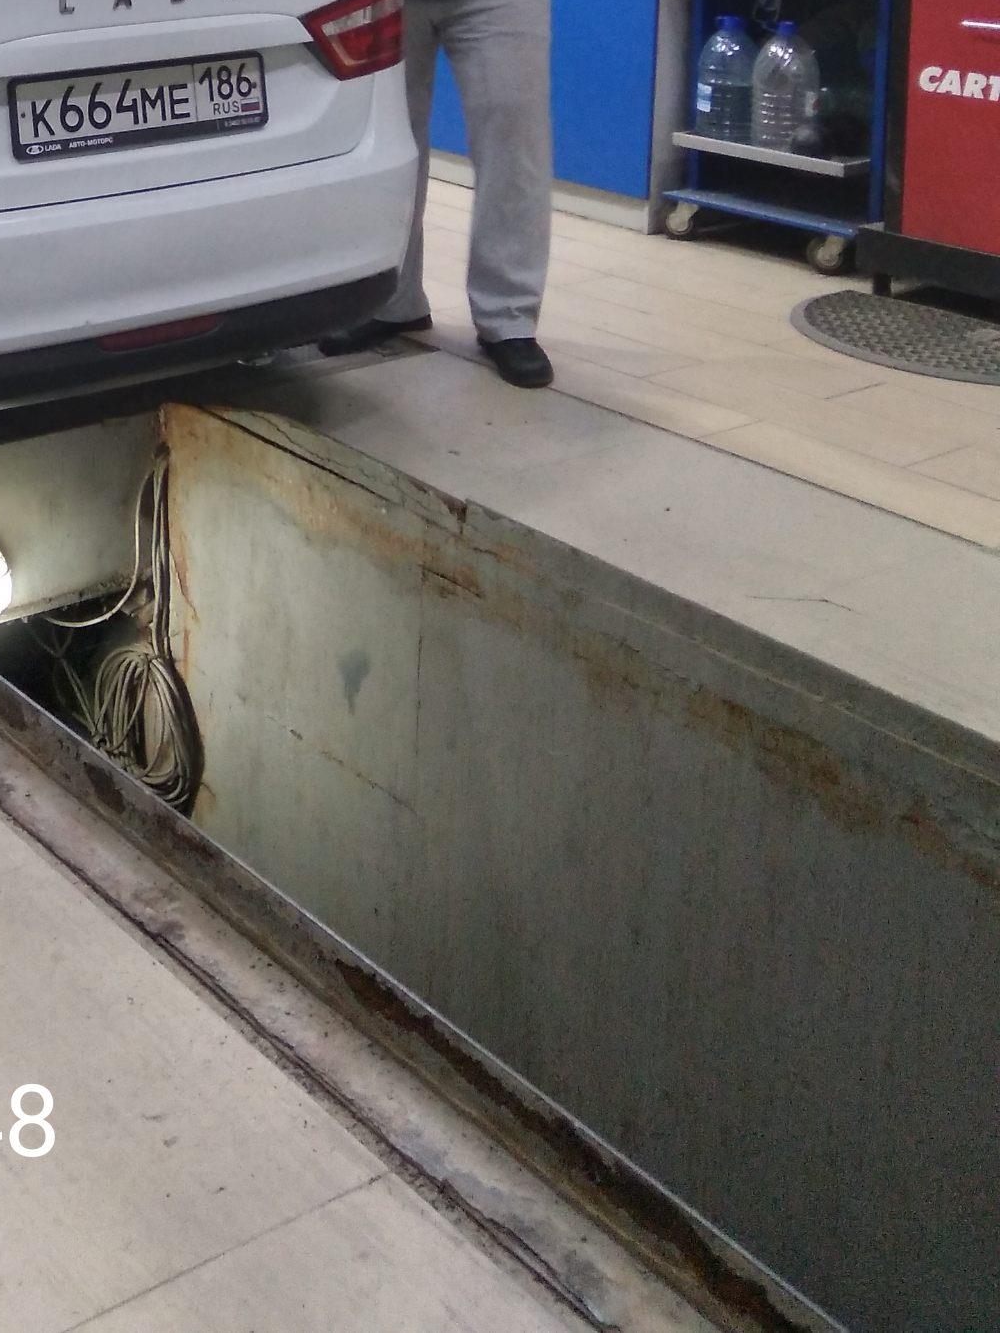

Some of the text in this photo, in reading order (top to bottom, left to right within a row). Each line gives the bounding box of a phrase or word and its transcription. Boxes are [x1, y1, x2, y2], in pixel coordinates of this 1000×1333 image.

[198, 63, 252, 103] 186
[213, 100, 240, 115] RUS
[44, 143, 62, 152] LADA
